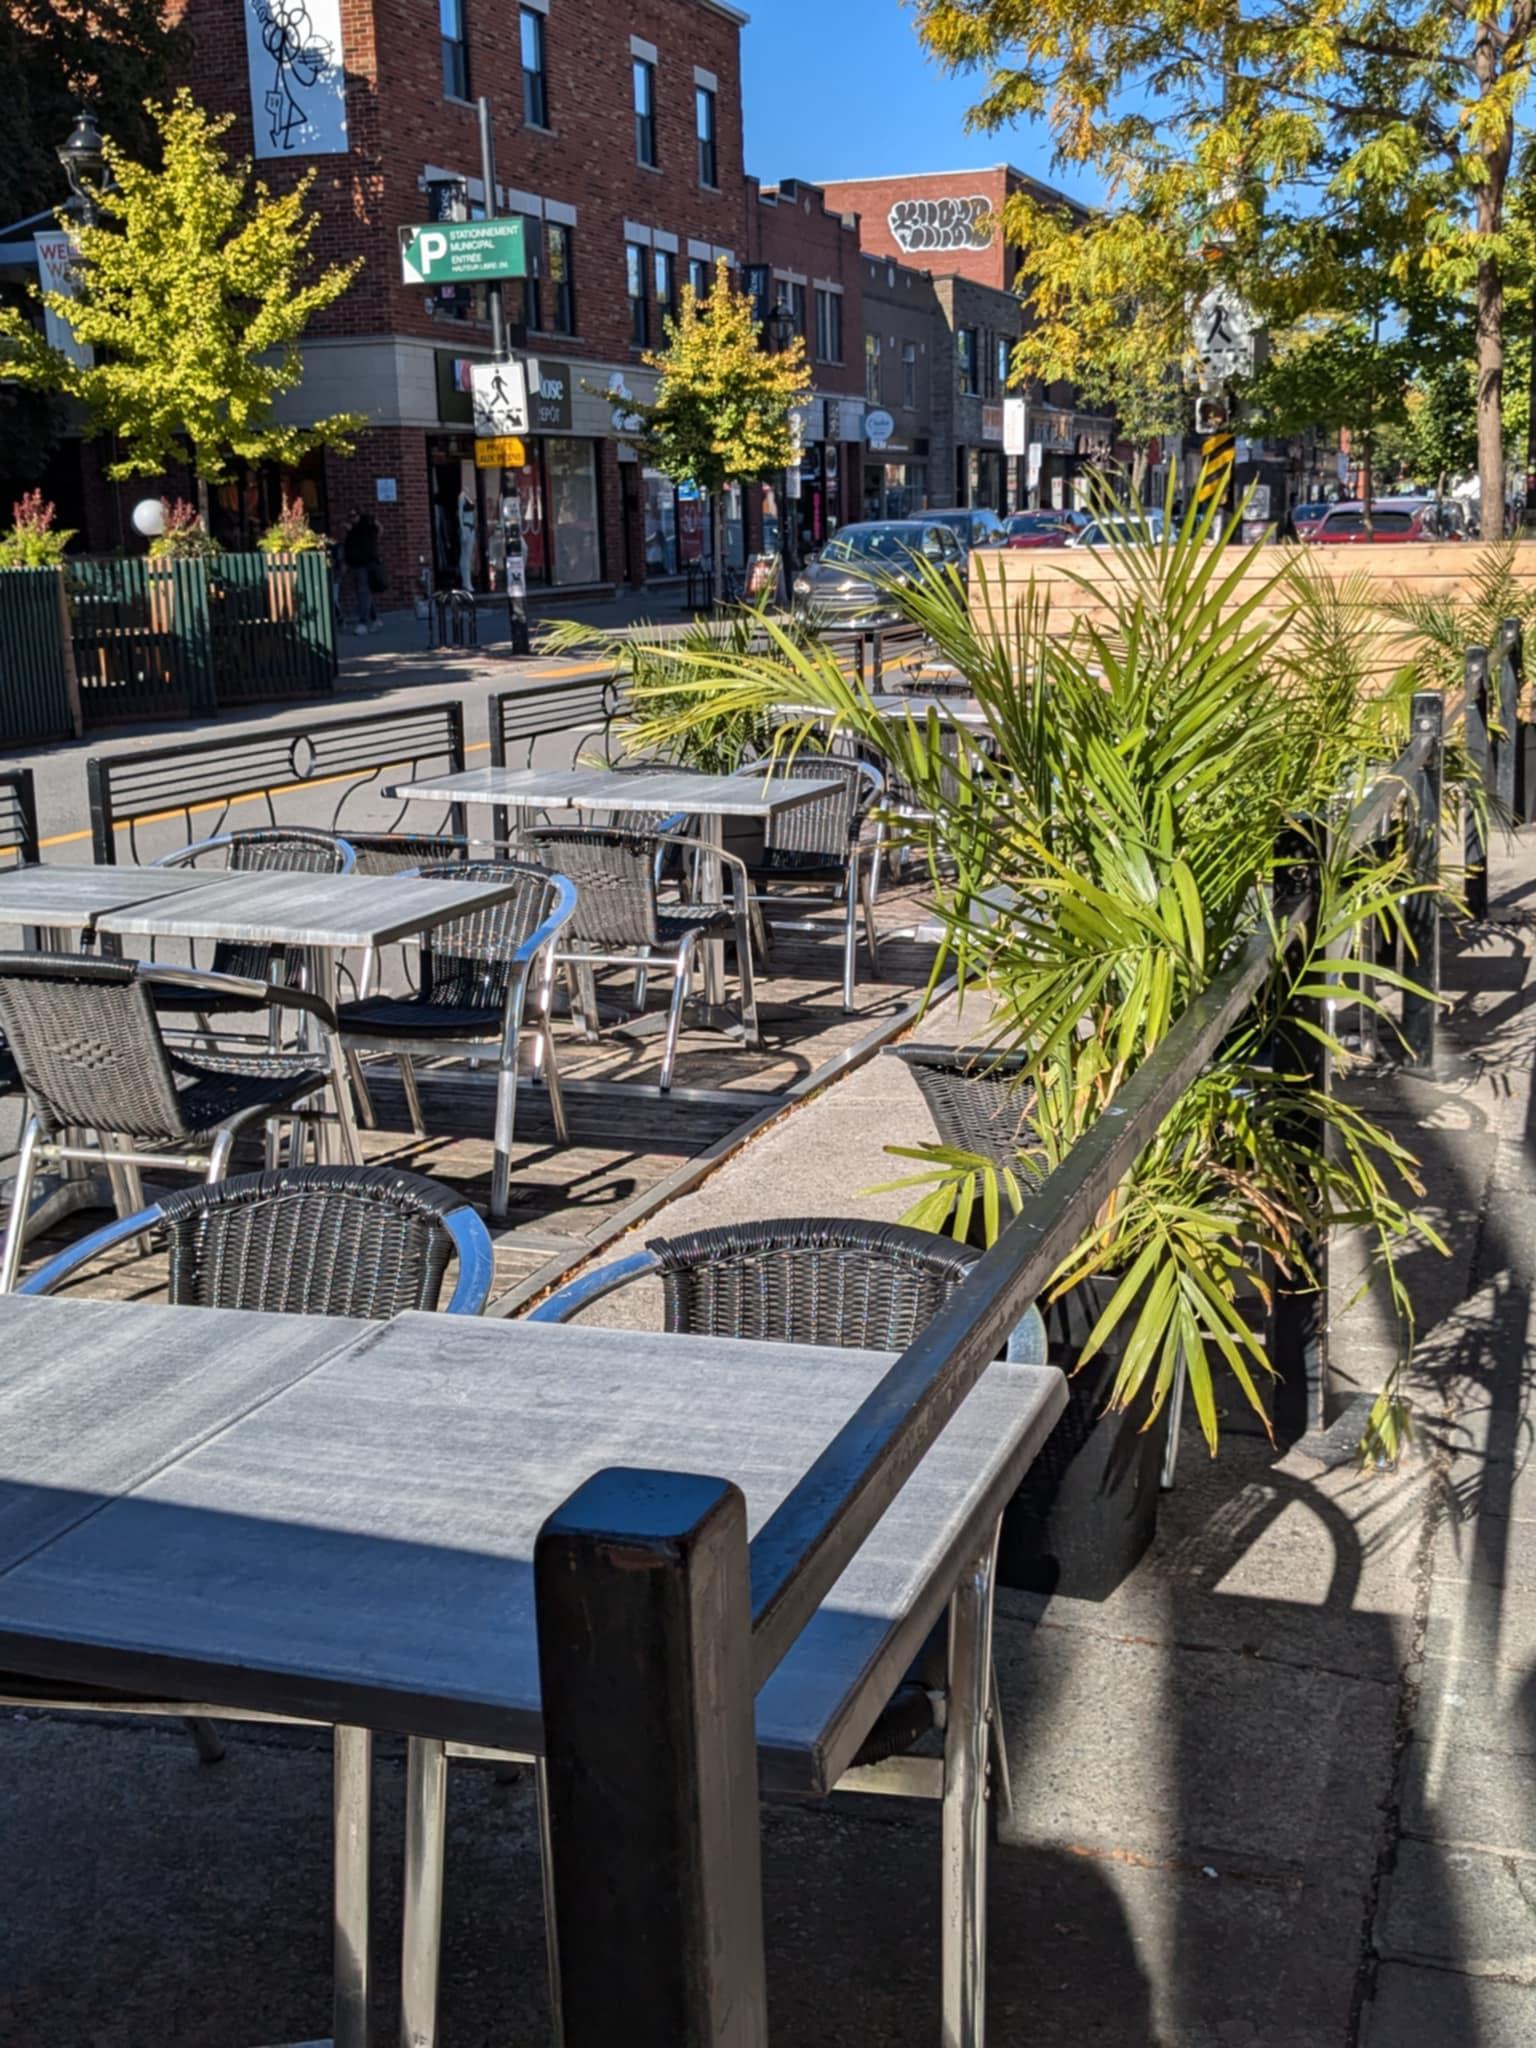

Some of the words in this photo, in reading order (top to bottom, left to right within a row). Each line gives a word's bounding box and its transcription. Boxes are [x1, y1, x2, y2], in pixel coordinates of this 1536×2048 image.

[450, 225, 518, 240] STATIONNEMENT
[450, 240, 495, 251] MUNICIPAL
[420, 232, 447, 275] P
[451, 253, 481, 264] ENTRÉE
